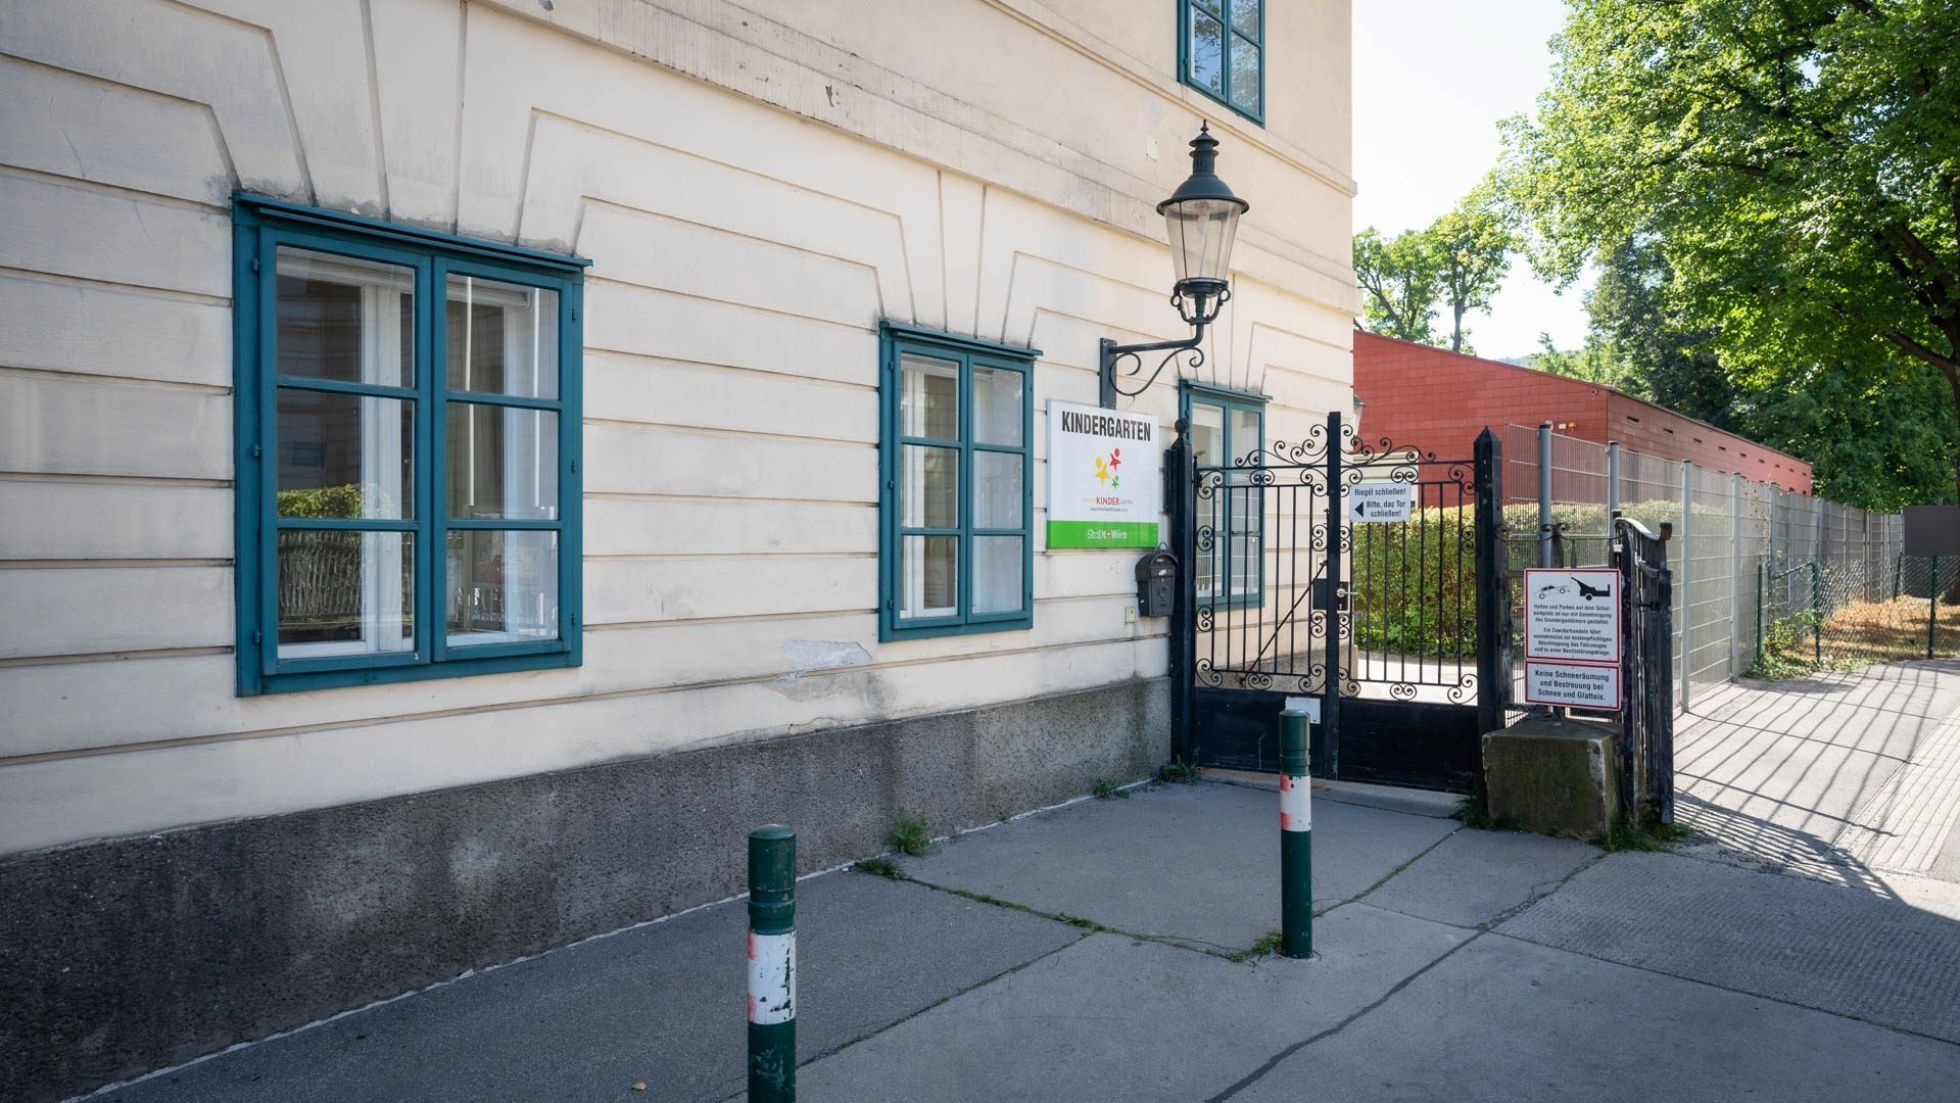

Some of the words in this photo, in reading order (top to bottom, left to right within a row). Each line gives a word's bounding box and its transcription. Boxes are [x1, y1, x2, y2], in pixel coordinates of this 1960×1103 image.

[1062, 411, 1151, 441] KINDERGARTEN
[1354, 488, 1373, 497] Riegel
[1555, 670, 1609, 682] Schneeräumung
[1554, 681, 1591, 691] Bestreuung
[1538, 688, 1561, 697] Schnee
[1577, 692, 1605, 700] Glatteis.
